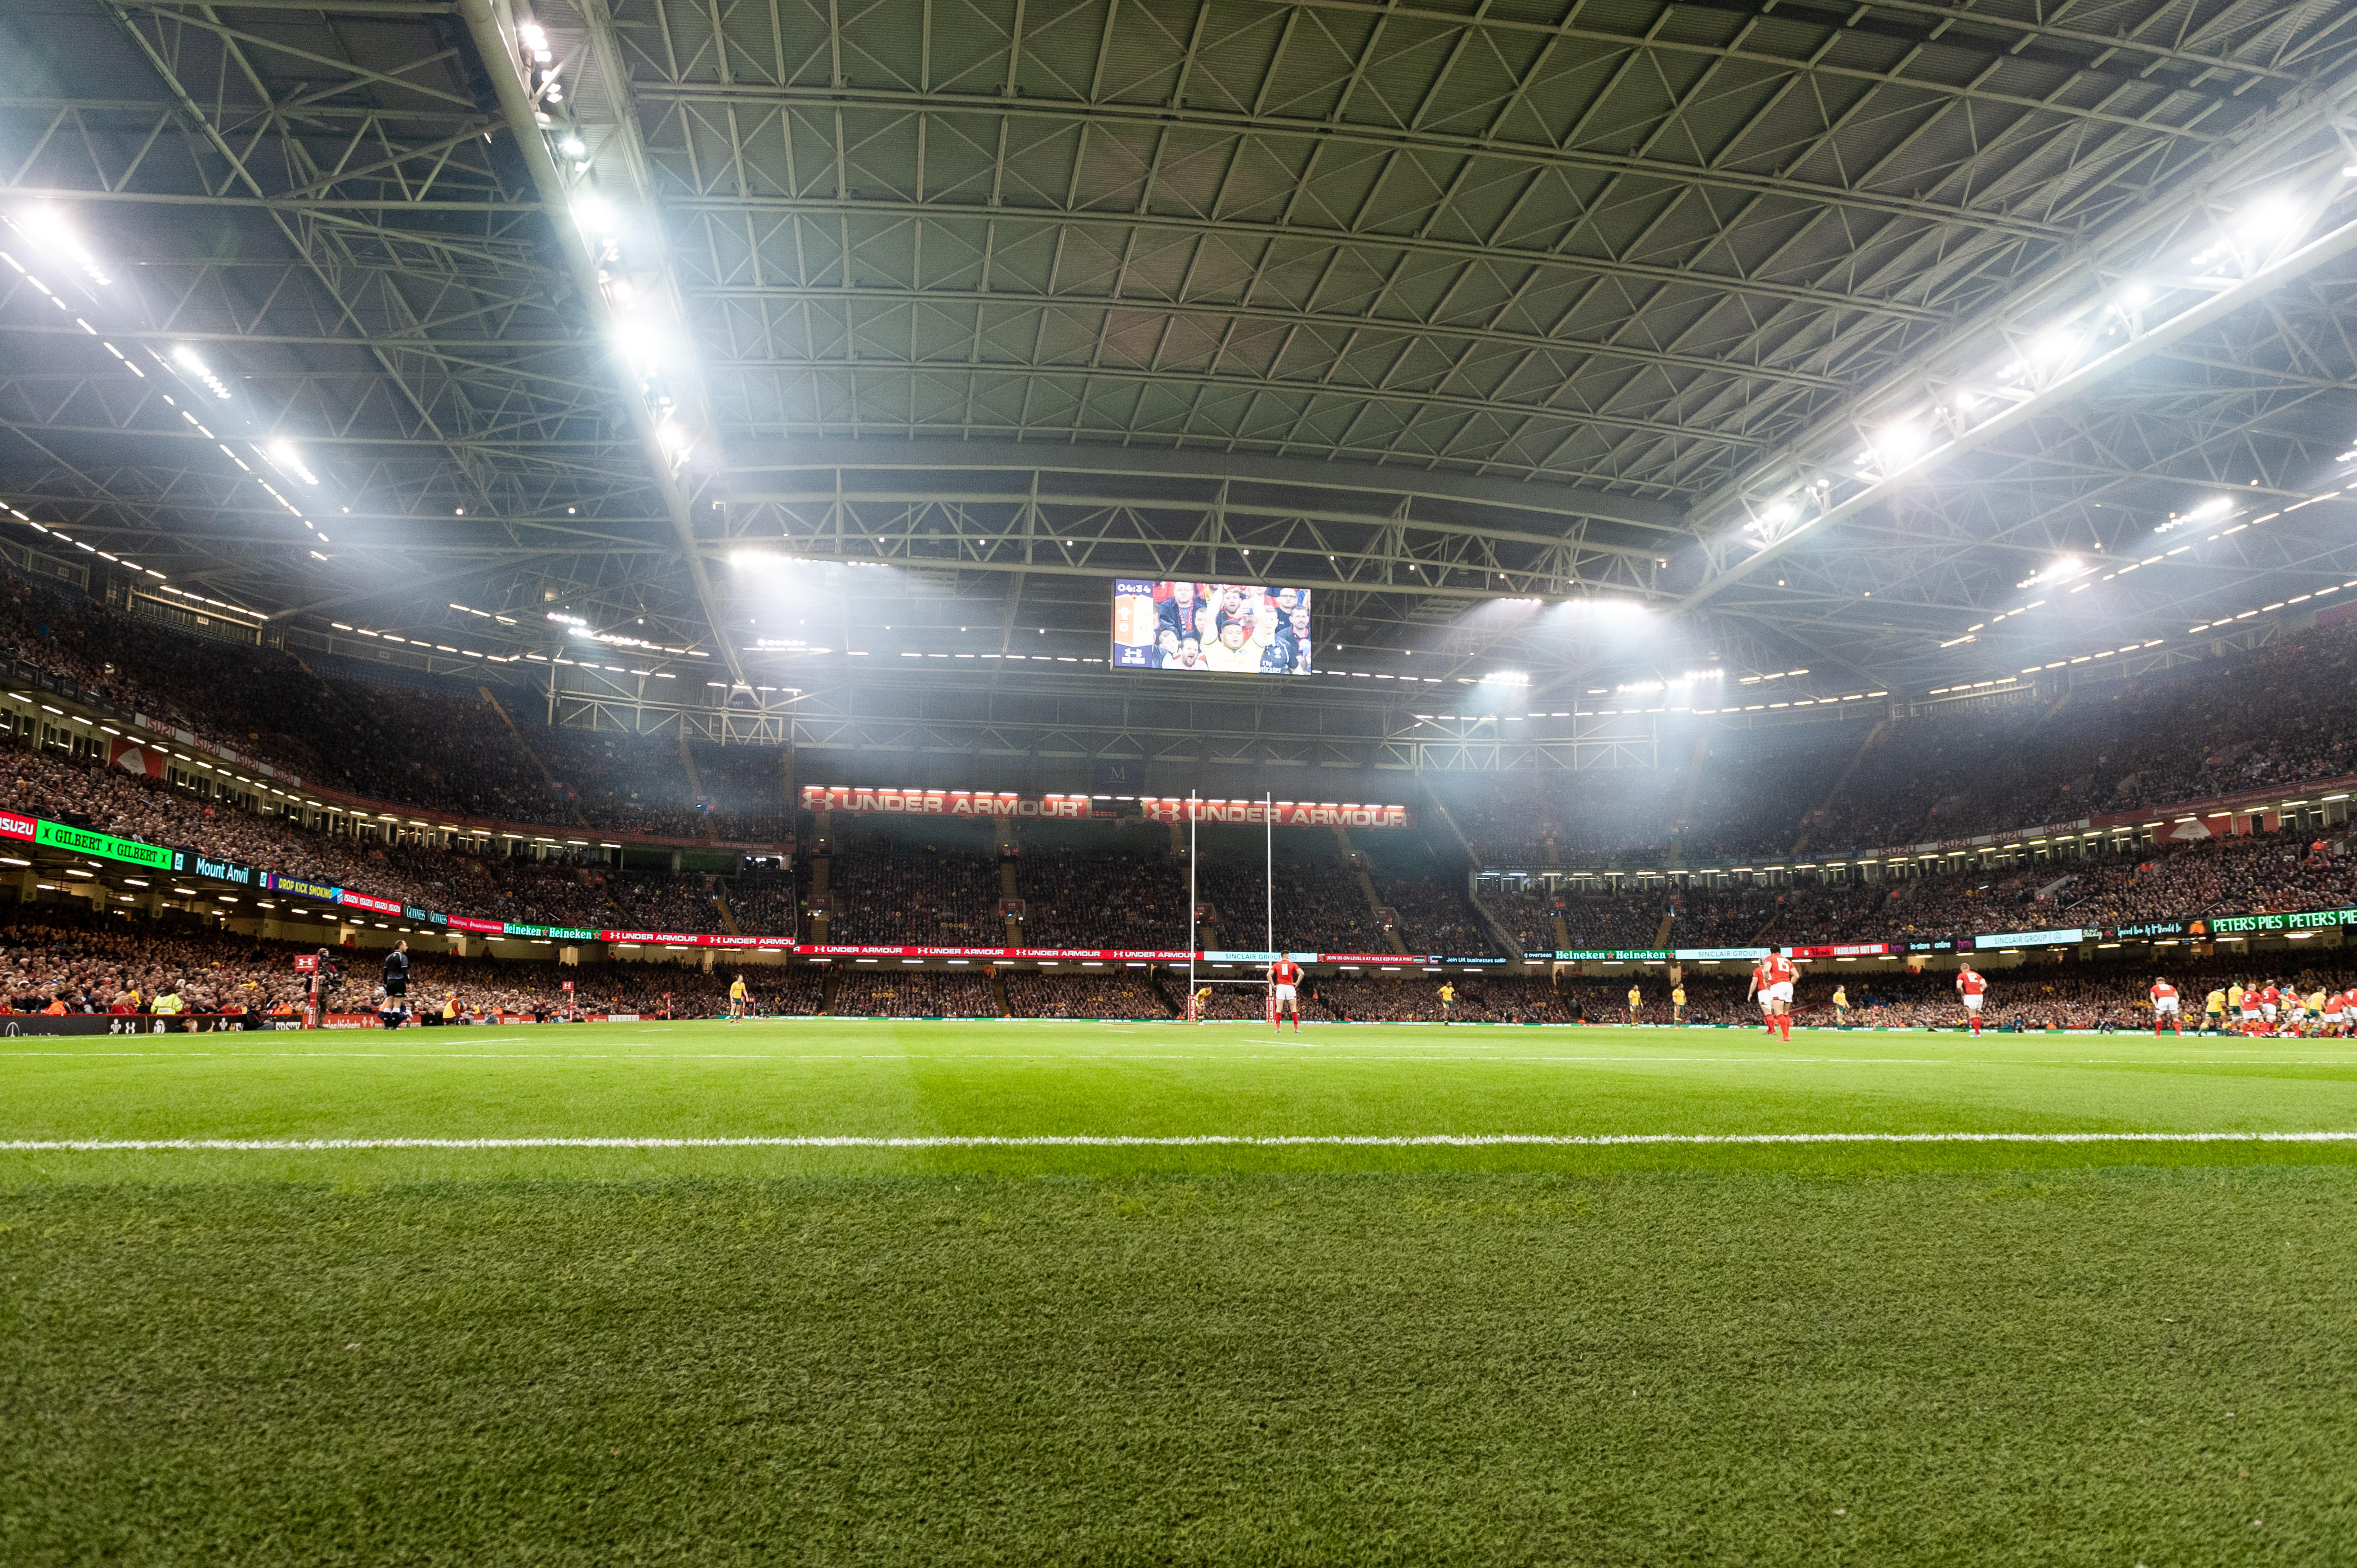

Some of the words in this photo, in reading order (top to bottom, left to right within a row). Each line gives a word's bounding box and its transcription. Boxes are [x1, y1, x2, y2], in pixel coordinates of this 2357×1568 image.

[1117, 584, 1151, 593] 04:34
[145, 716, 177, 739] ISUZU
[193, 734, 221, 755] ISUZU
[235, 752, 260, 770] ISUZU
[272, 767, 295, 784] ISUZU
[842, 794, 943, 813] UNDER
[1188, 807, 1282, 823] UNDER
[1289, 809, 1407, 827] ARMOUR
[0, 817, 34, 836] ISUZU
[2043, 820, 2078, 834] ISUZU
[56, 829, 102, 851] GILBERT
[1991, 829, 2023, 843] ISUZU
[1878, 844, 1916, 857] ISUZU
[1937, 837, 1973, 850] ISUZU
[117, 844, 158, 863] GILBERT
[196, 857, 225, 880] Mount
[226, 864, 249, 884] Anvil
[278, 877, 294, 890] DROP
[295, 881, 308, 894] KICK
[309, 884, 332, 899] SMOKING
[344, 893, 358, 904] ISUZU
[359, 898, 373, 907] ISUZU
[374, 901, 387, 910] ISUZU
[388, 904, 401, 913] ISUZU
[406, 905, 426, 921] GUINNESS
[430, 910, 448, 925] GUINNESS
[2258, 915, 2283, 929] PIES
[503, 923, 541, 937] Heineken
[549, 927, 592, 939] Heineken
[1957, 939, 1974, 948] hmv
[1994, 935, 2023, 944] SINCLAIR
[2024, 934, 2047, 943] GROUP
[1555, 951, 1605, 959] Heineken
[1616, 951, 1666, 959] Heineken
[1281, 964, 1289, 975] 11
[1966, 973, 1979, 983] 12
[2244, 993, 2251, 1002] 2
[2263, 991, 2269, 999] 5
